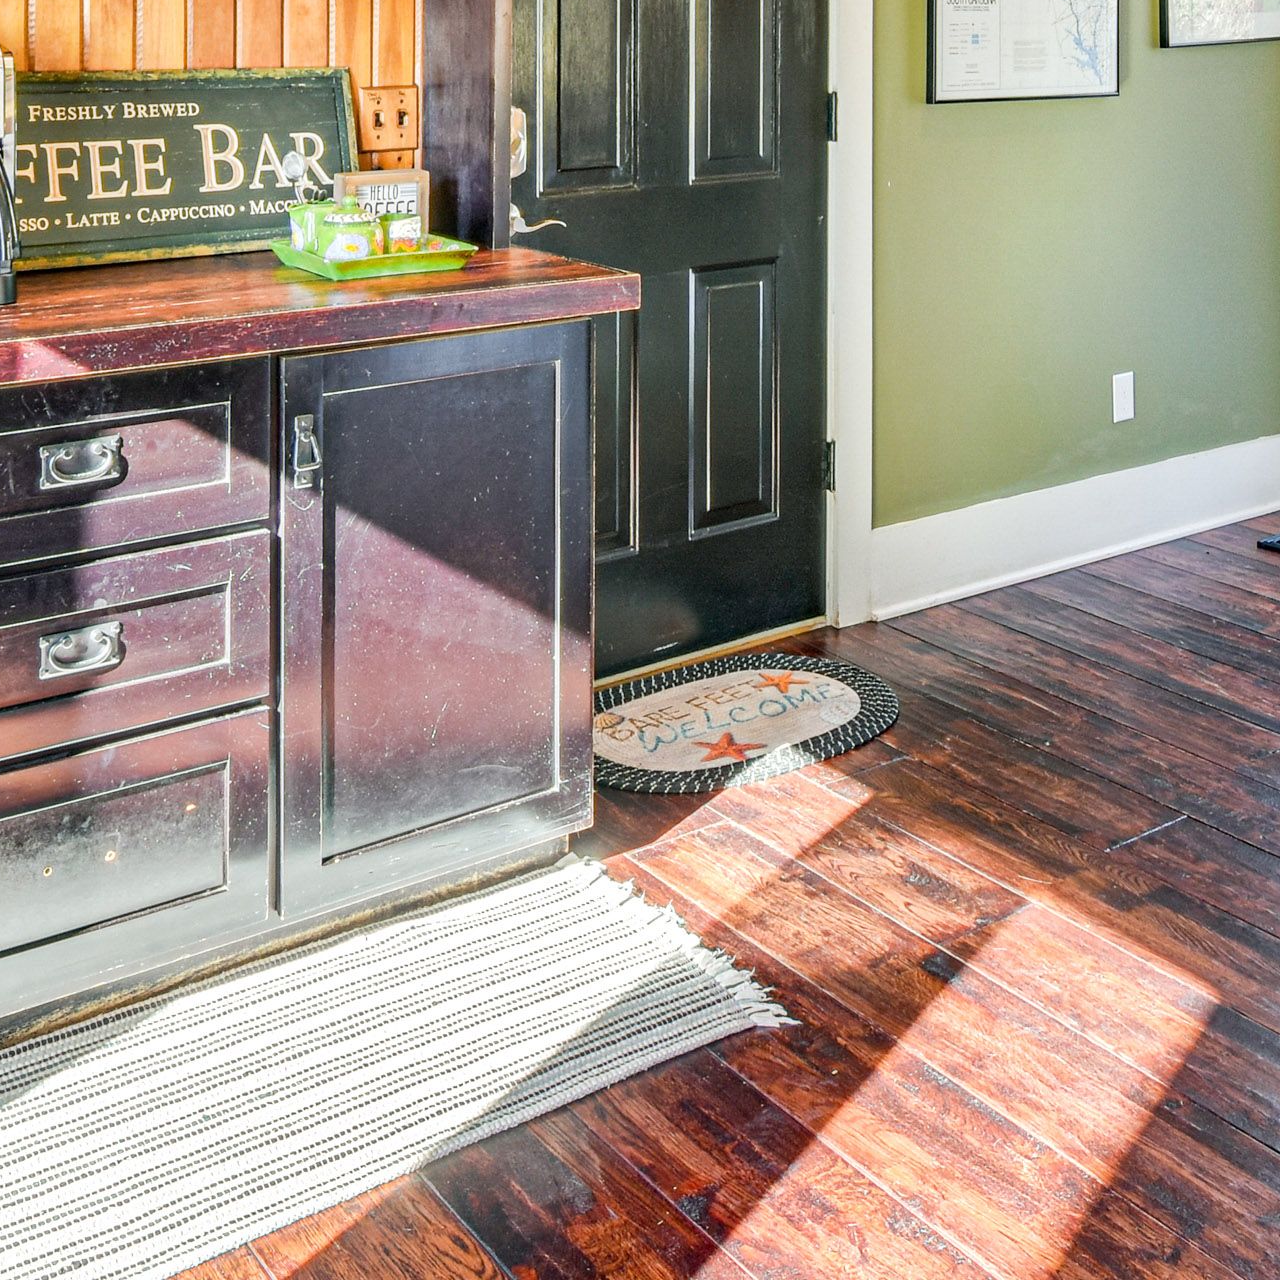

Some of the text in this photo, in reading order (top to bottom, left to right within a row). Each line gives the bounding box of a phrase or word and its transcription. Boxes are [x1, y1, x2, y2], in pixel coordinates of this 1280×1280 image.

[28, 102, 200, 122] FRESHLY BREWED
[15, 124, 335, 204] FFEE BAR
[370, 184, 399, 201] HELLO
[19, 217, 50, 232] SSO
[66, 212, 120, 228] LATTE
[137, 204, 235, 223] CAPPUCCINO
[609, 678, 756, 741] BARE FEET
[637, 683, 844, 754] WELCOME
